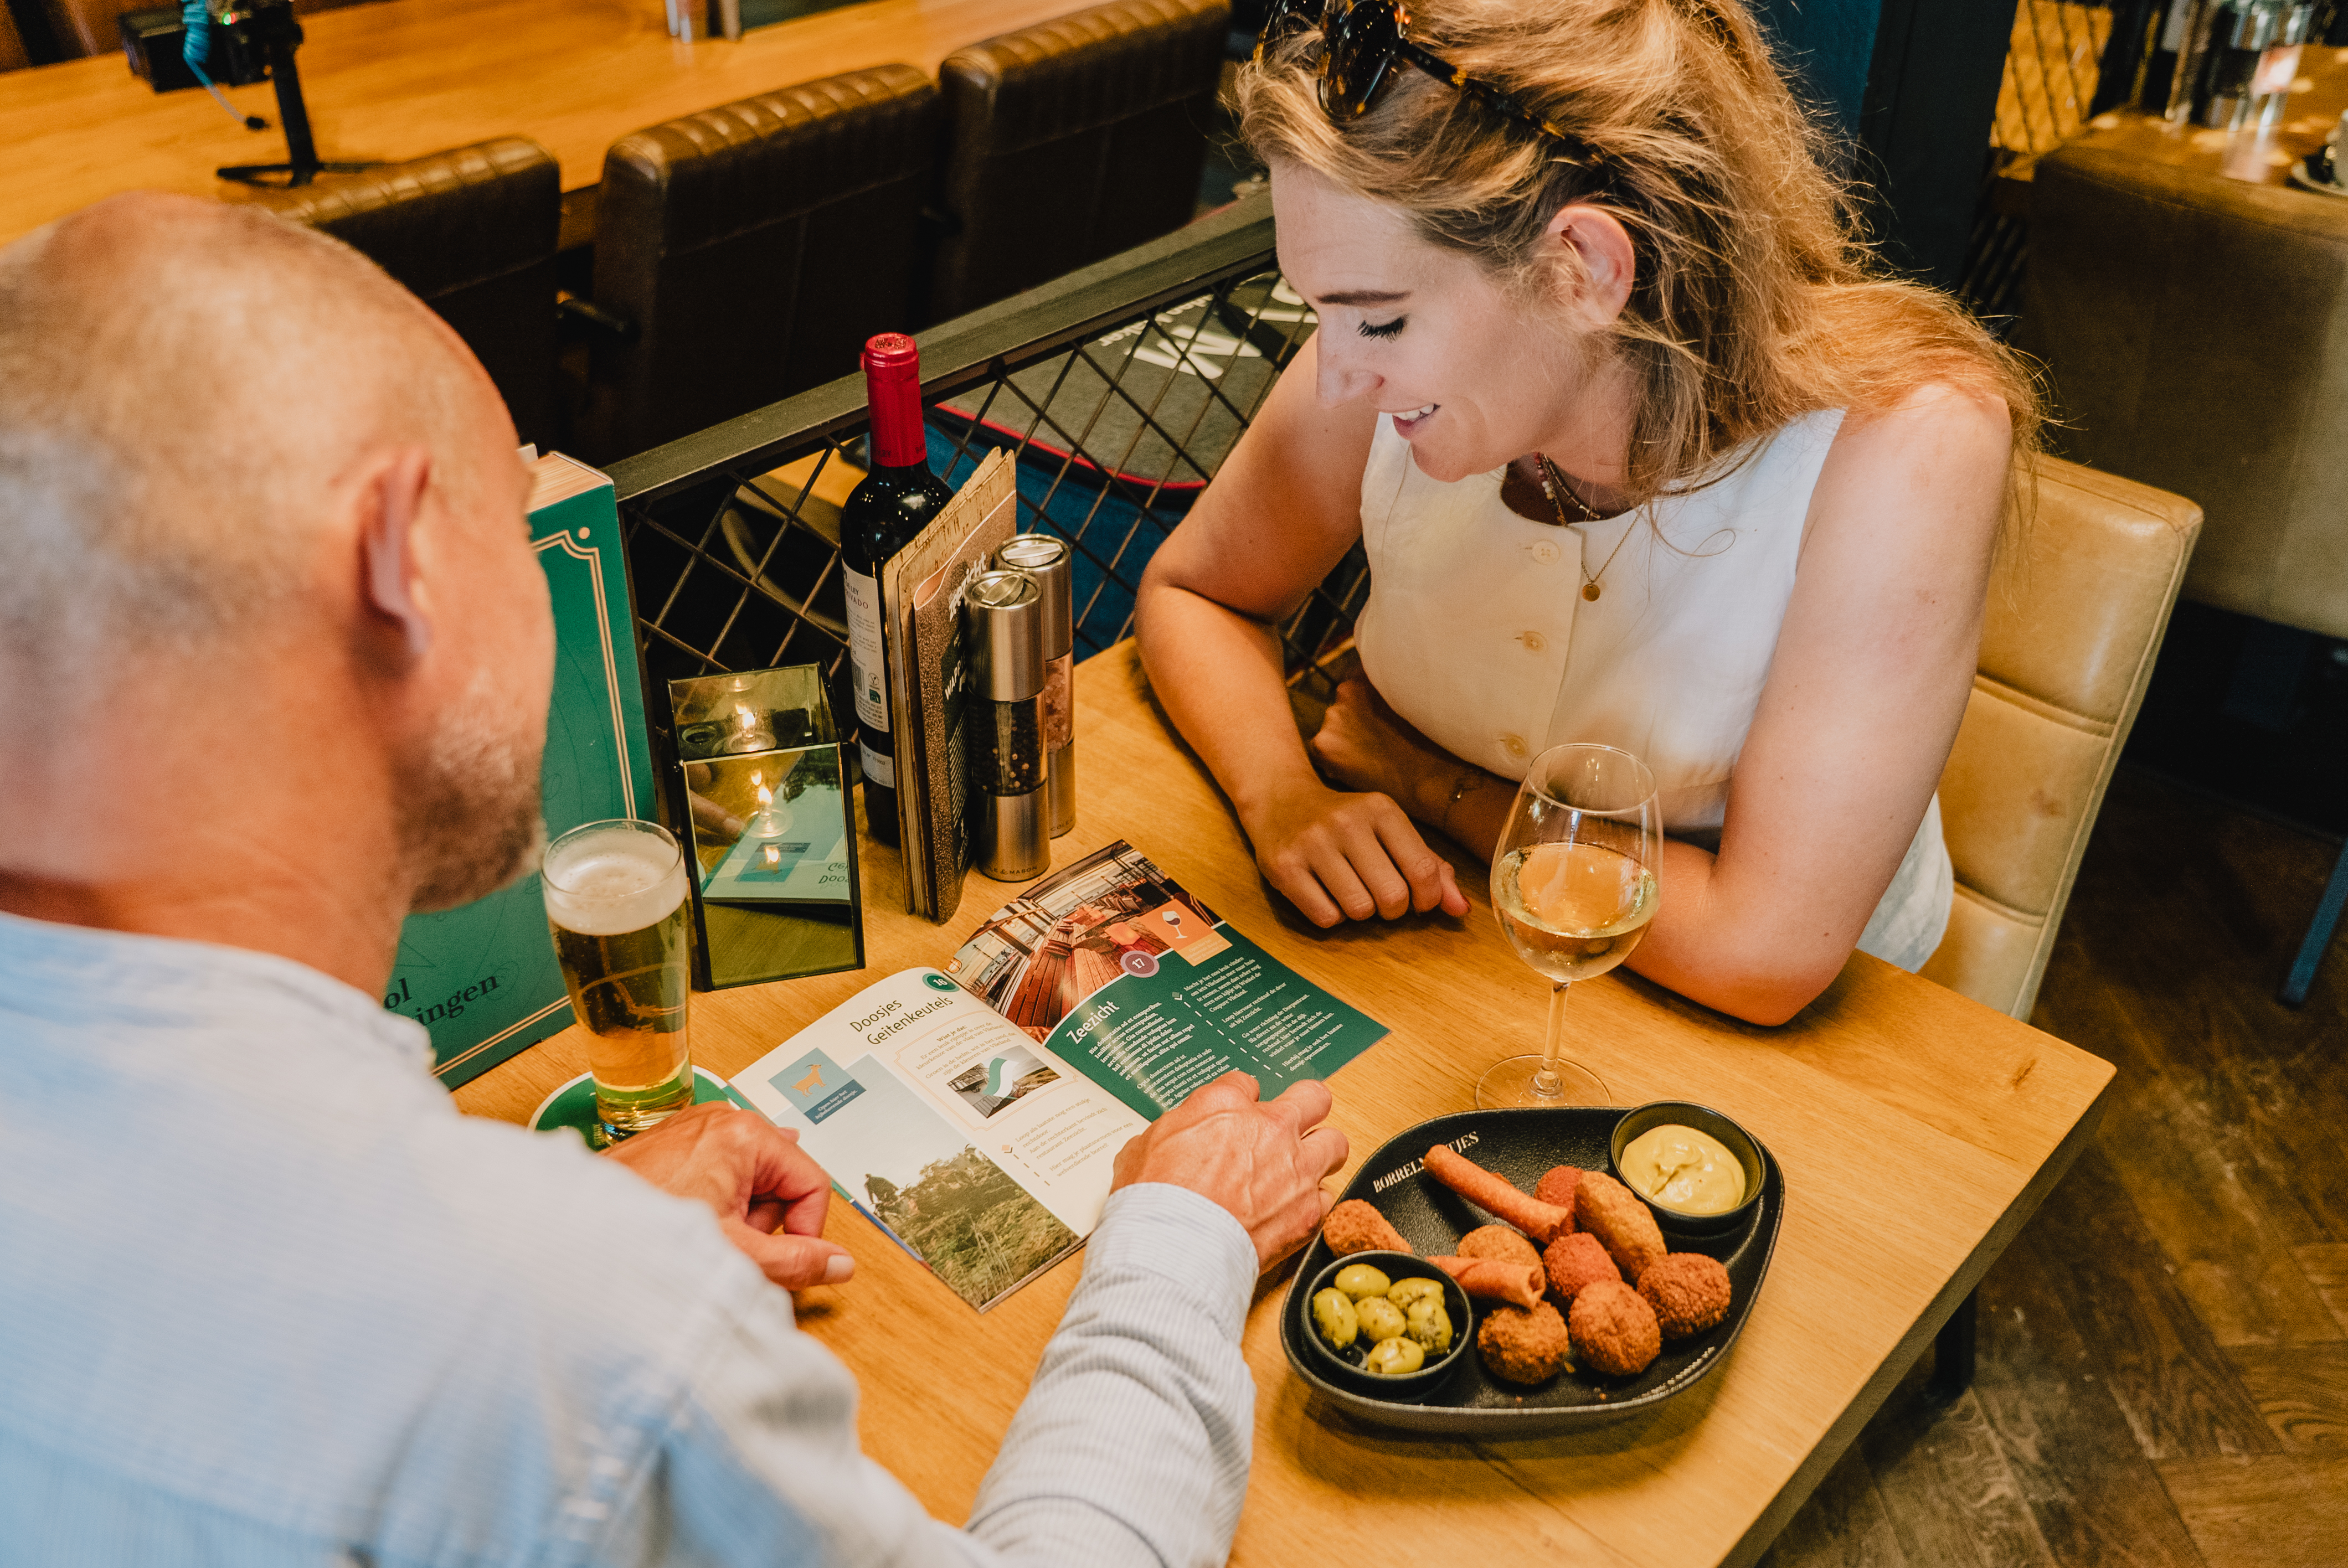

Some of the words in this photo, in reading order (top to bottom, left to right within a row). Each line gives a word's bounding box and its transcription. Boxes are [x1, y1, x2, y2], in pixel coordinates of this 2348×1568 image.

[1009, 866, 1038, 875] MASON
[1132, 957, 1145, 969] 17
[1183, 981, 1200, 992] Mocht
[1228, 957, 1244, 967] vinden
[1205, 975, 1227, 988] Vlielands
[1225, 969, 1237, 978] mee
[1235, 964, 1246, 972] naar
[1218, 982, 1232, 991] neem
[1238, 969, 1252, 978] zeker
[1221, 988, 1235, 997] kijkje
[1238, 974, 1256, 986] Winkel
[416, 976, 501, 1027] ingen
[1208, 999, 1229, 1013] Coupure
[1221, 1015, 1235, 1023] Loop
[1232, 1003, 1253, 1017] hiervoor
[1275, 982, 1286, 991] deur
[849, 1000, 902, 1033] Doosjes
[867, 997, 954, 1045] Geitenkeutels
[1065, 1000, 1120, 1045] Zeezicht
[1248, 1024, 1261, 1034] weer
[1260, 1013, 1280, 1027] richting
[1256, 1028, 1271, 1039] direct
[1280, 1013, 1294, 1022] witte
[1279, 1032, 1291, 1040] hier
[1289, 1022, 1309, 1034] bevindt
[1306, 1015, 1317, 1024] zich
[936, 1033, 951, 1042] Wist
[937, 1040, 951, 1049] leuk
[950, 1031, 969, 1043] rijmpje
[1088, 1045, 1099, 1055] Bis
[1097, 1025, 1124, 1047] doluptatis
[1112, 1031, 1126, 1044] accus
[1146, 1023, 1168, 1036] voluptas
[1254, 1026, 1288, 1048] toegangspoort
[1268, 1045, 1285, 1058] winkel
[1283, 1038, 1296, 1048] waar
[1299, 1028, 1310, 1038] naar
[1307, 1018, 1326, 1030] binnen
[1096, 1040, 1132, 1064] invendunt.
[1111, 1064, 1121, 1072] hil
[1160, 1027, 1173, 1037] dolor
[1158, 1046, 1171, 1055] alite
[1201, 1048, 1212, 1056] solo
[1281, 1054, 1300, 1067] Hierbij
[1297, 1047, 1310, 1056] mag
[1326, 1023, 1343, 1035] laatste
[915, 1050, 946, 1070] kleurkeuze
[925, 1067, 944, 1079] Groen
[954, 1051, 972, 1060] helm,
[959, 1052, 981, 1065] kleuren
[1119, 1056, 1147, 1077] andusam,
[1289, 1059, 1306, 1071] doosje
[1136, 1077, 1151, 1089] Opta
[1149, 1061, 1175, 1079] dustectem
[1156, 1088, 1175, 1102] volupta
[1196, 1062, 1217, 1076] voluptat
[1216, 1055, 1230, 1066] quunt
[1161, 1097, 1176, 1108] fuga.
[1189, 1079, 1206, 1089] volore
[1216, 1064, 1230, 1074] vidus
[1164, 1076, 1178, 1087] sequi
[817, 1102, 831, 1111] Open
[829, 1095, 840, 1103] hier
[1015, 1132, 1030, 1142] Loop
[1036, 1116, 1055, 1128] laatste
[1054, 1110, 1067, 1118] nog
[1075, 1098, 1091, 1107] stukje
[1022, 1129, 1051, 1148] rechtdoor.
[1029, 1146, 1041, 1154] Aan
[1047, 1122, 1078, 1142] rechterkant
[1076, 1112, 1098, 1124] bevindt
[1036, 1140, 1064, 1159] restaurant
[1049, 1162, 1062, 1172] Hier
[1062, 1154, 1075, 1163] mag
[1079, 1132, 1112, 1153] plaatsnemen
[1057, 1153, 1091, 1177] welverdiende
[1373, 1131, 1479, 1194] BORRELTJES
